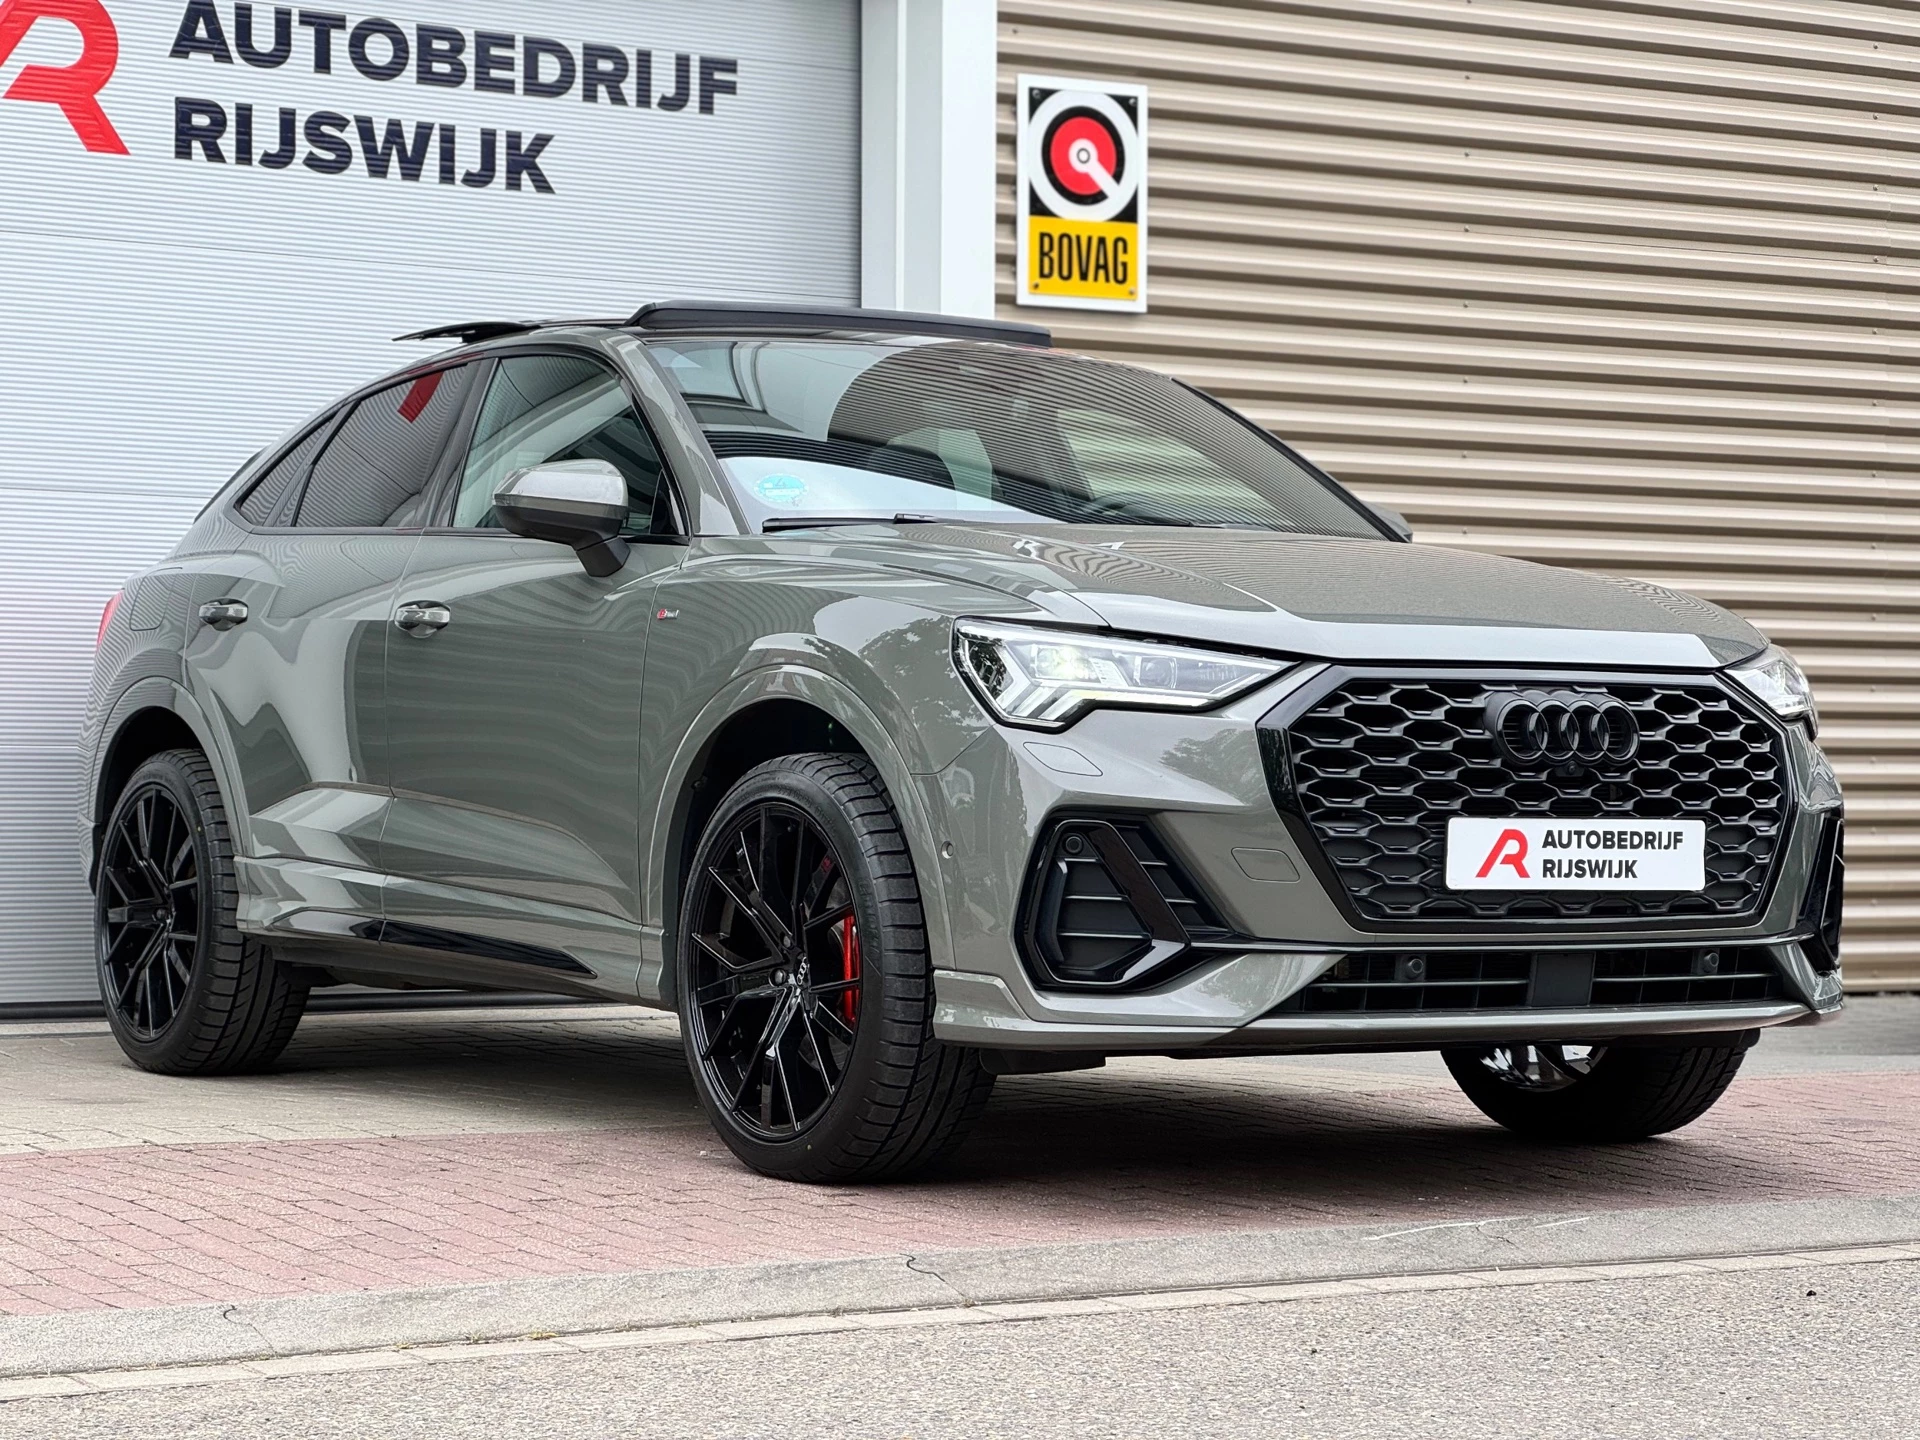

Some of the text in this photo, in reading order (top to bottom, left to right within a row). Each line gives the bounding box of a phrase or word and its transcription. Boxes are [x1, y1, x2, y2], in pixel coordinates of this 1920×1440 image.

[168, 0, 738, 115] AUTOBEDRIJF
[174, 96, 556, 194] RIJSWIJK
[1039, 231, 1128, 285] BOVAG
[1541, 829, 1684, 851] AUTOBEDRIJF
[1542, 858, 1638, 879] RIJSWIJK
